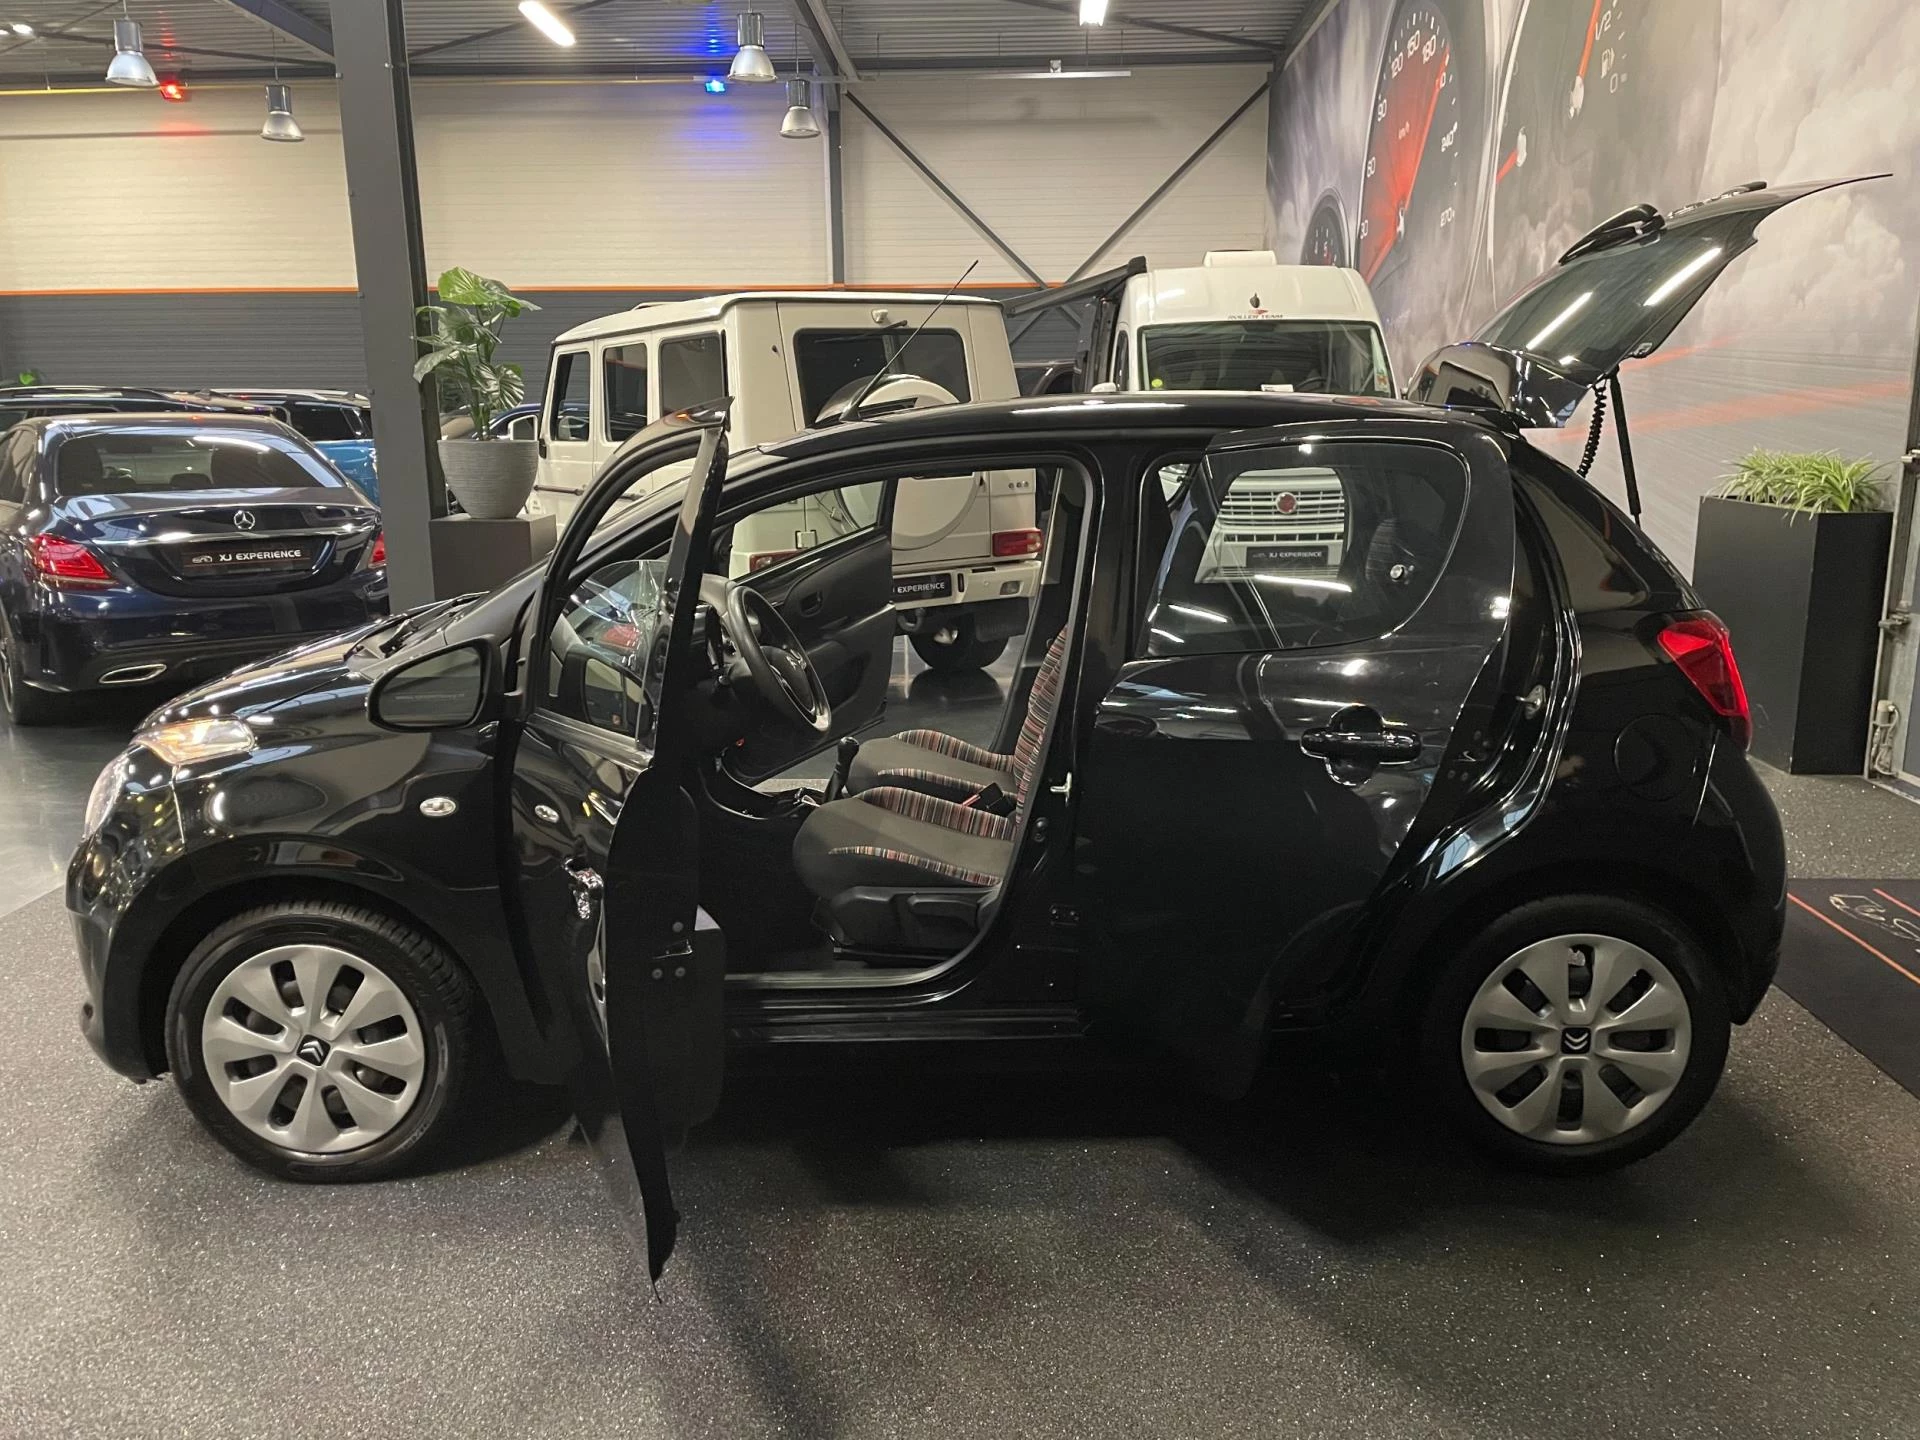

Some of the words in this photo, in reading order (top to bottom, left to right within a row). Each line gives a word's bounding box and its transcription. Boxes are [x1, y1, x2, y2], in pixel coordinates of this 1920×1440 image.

[219, 553, 233, 562] XJ
[235, 549, 302, 561] EXPERIENCE
[897, 581, 945, 594] EXPERIENCE
